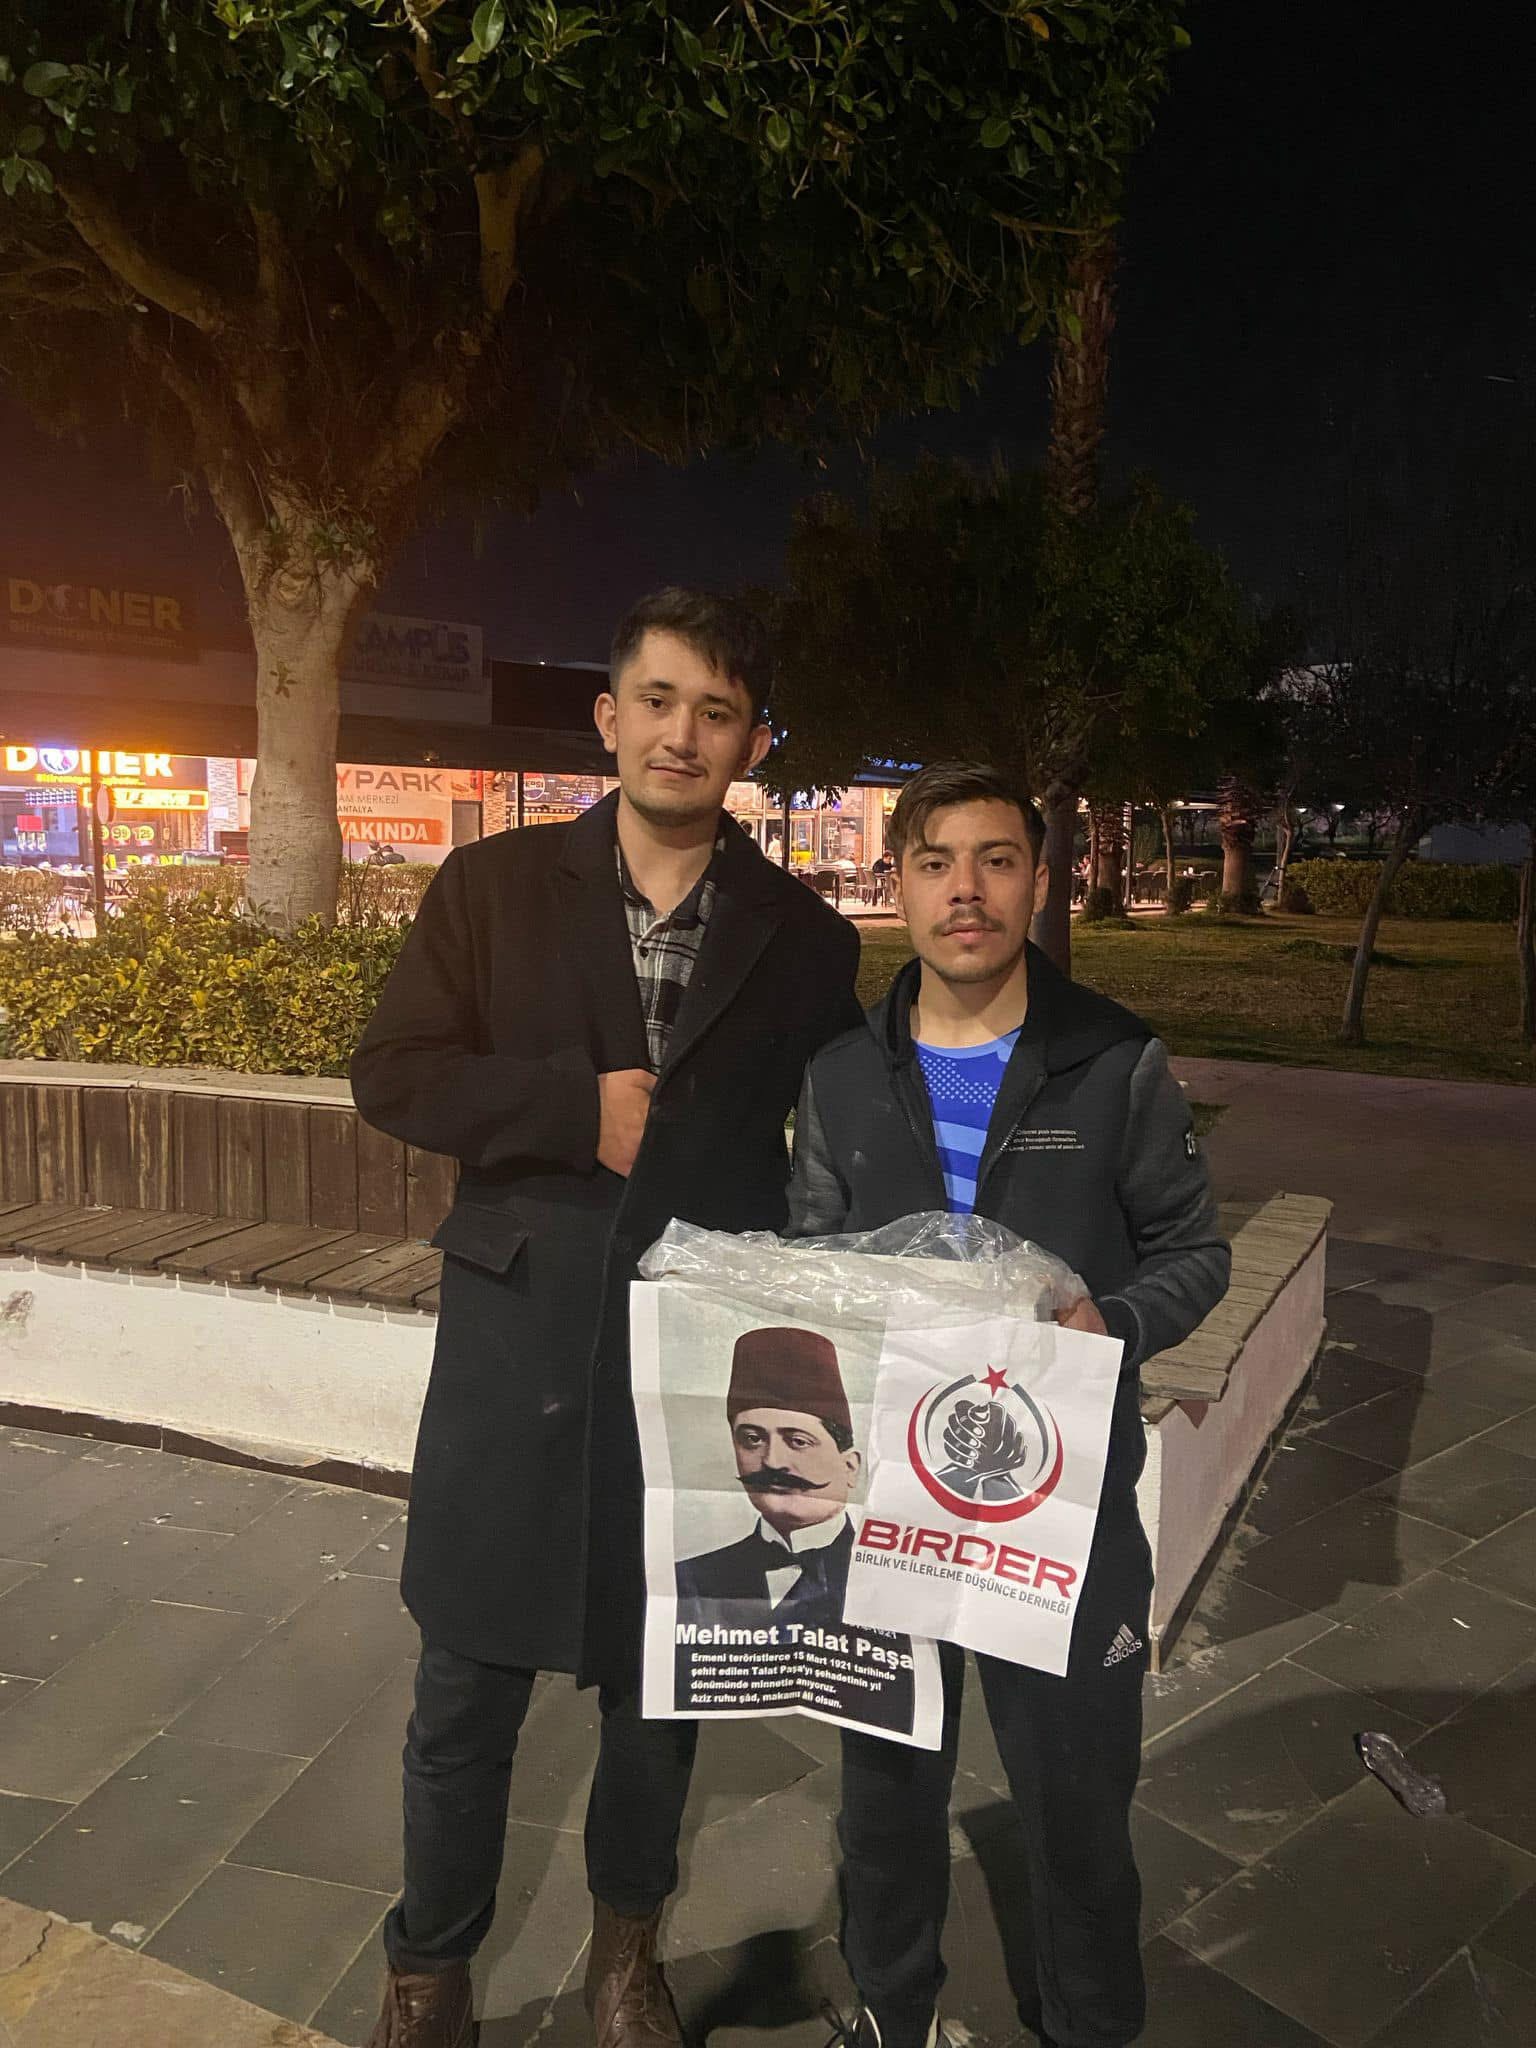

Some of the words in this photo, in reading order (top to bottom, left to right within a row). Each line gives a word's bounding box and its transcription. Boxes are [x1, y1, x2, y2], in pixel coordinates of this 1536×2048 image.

[337, 805, 373, 814] ANTALYA
[855, 1551, 892, 1569] BİRLİK
[893, 1559, 907, 1571] VE
[908, 1559, 963, 1582] İLERLEME
[965, 1573, 1017, 1599] DÜŞÜNCE
[1018, 1590, 1072, 1616] DERNEĞİ
[675, 1624, 780, 1645] Mehmet
[786, 1623, 849, 1653] Talat
[856, 1637, 914, 1670] Paşa
[1104, 1639, 1142, 1667] adidas
[691, 1652, 726, 1662] Ermeni
[729, 1652, 791, 1662] teröristlerce
[793, 1651, 804, 1660] 15
[806, 1652, 827, 1665] Mart
[830, 1658, 851, 1670] 1921
[854, 1663, 896, 1681] tarihinde
[691, 1666, 716, 1677] şehit
[718, 1666, 749, 1676] edilen
[752, 1666, 777, 1675] Talat
[780, 1664, 812, 1675] Paşa'yı
[815, 1668, 868, 1688] şehadetinin
[691, 1680, 748, 1690] dönümünde
[751, 1679, 794, 1689] minnetle
[691, 1693, 712, 1703] Aziz
[714, 1693, 736, 1703] ruhu
